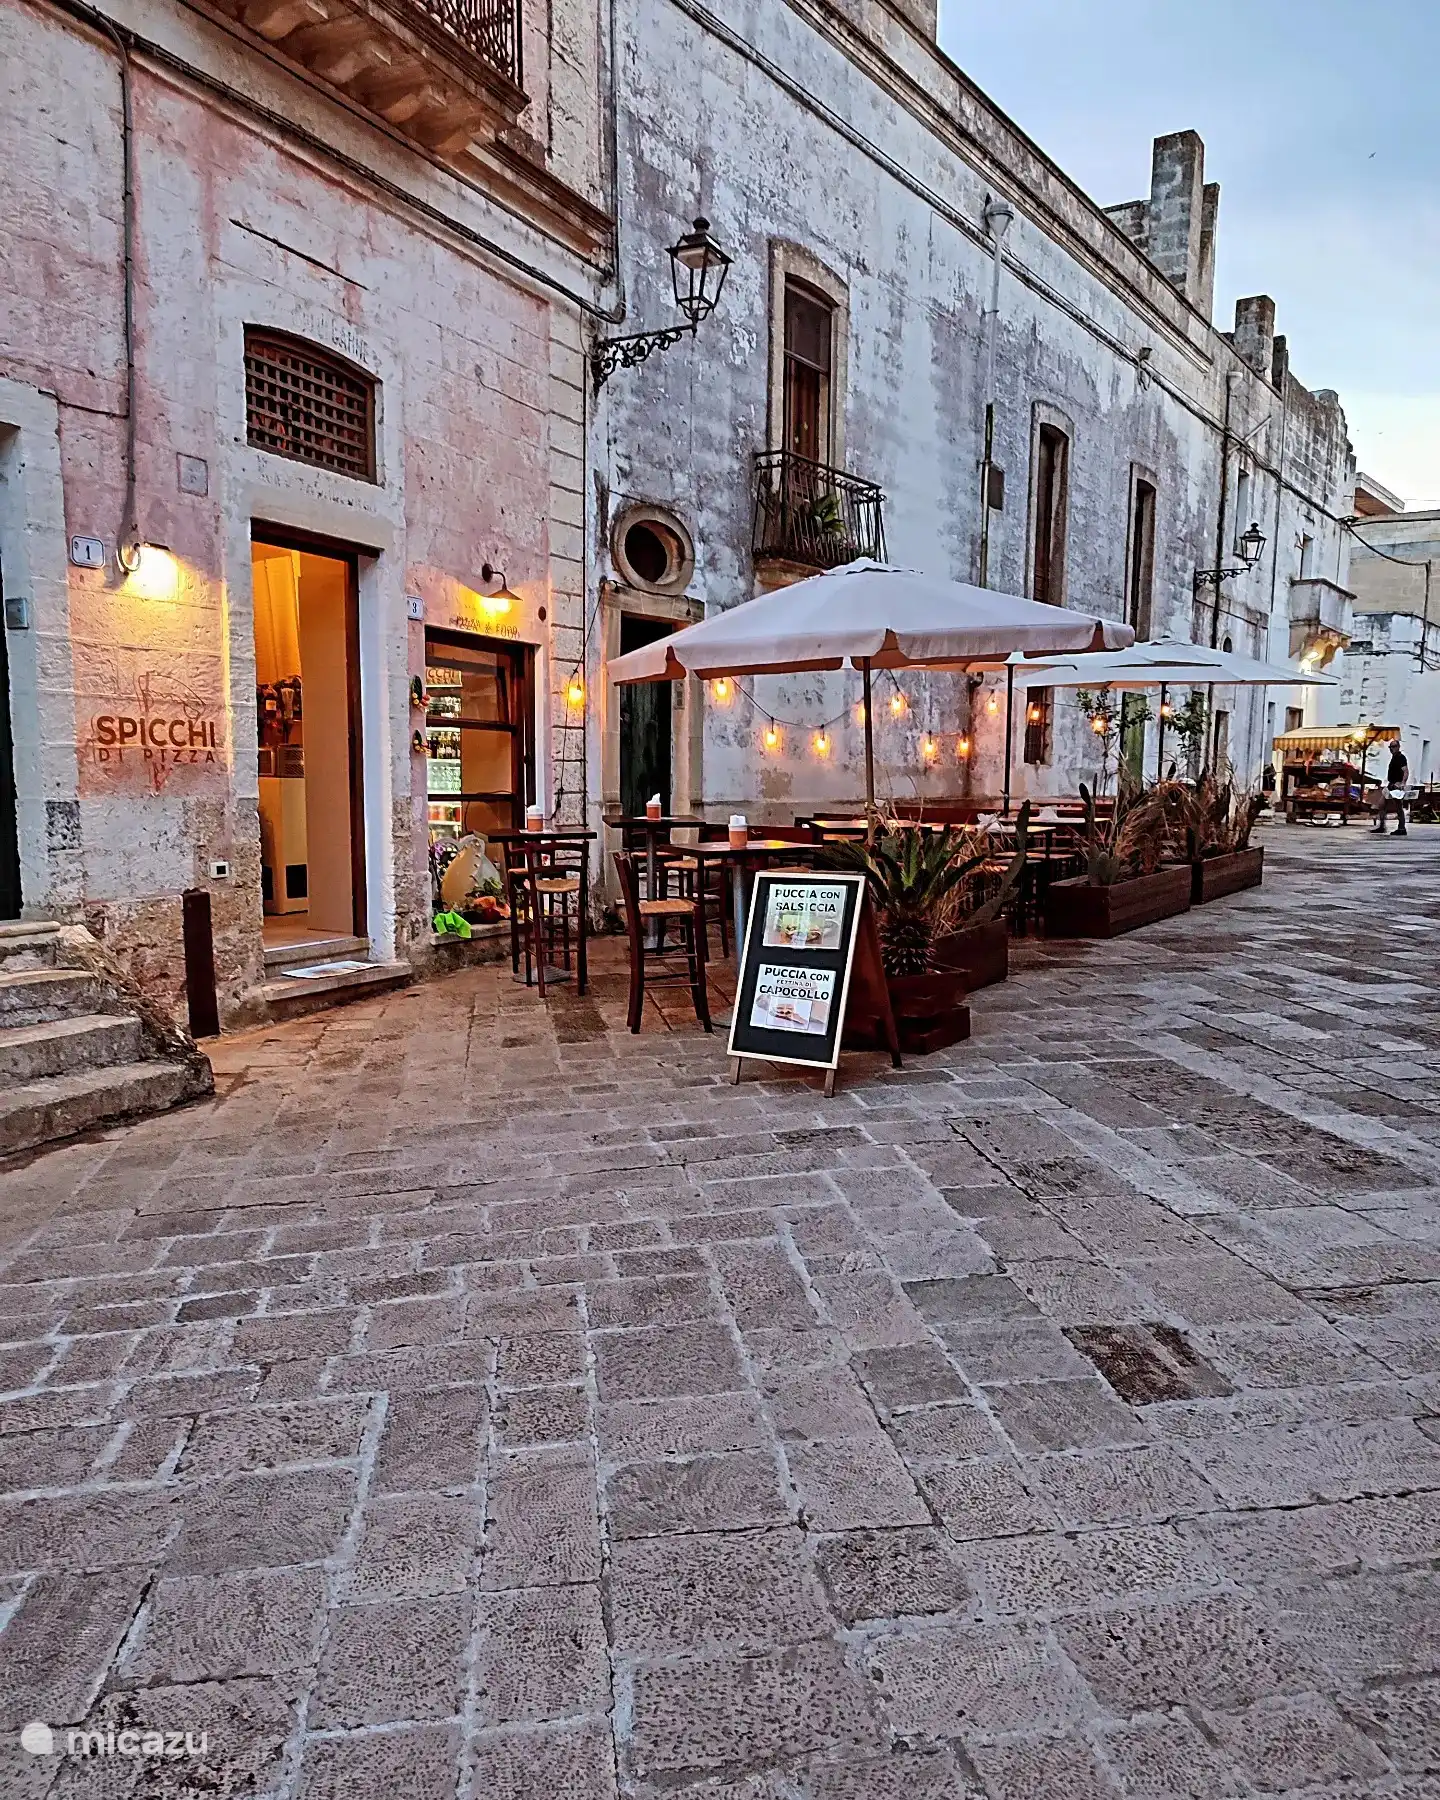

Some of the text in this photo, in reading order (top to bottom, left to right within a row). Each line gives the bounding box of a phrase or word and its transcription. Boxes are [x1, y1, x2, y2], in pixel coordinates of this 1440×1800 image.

[86, 545, 91, 560] 1
[412, 602, 417, 613] 3
[96, 715, 216, 748] SPICCHI
[99, 748, 215, 763] DI PIZZA
[775, 889, 840, 899] PUCCIA CON
[775, 902, 836, 912] SALSICCIA
[764, 967, 829, 982] PUCCIA CON
[759, 985, 829, 1000] CAPOCOLLO
